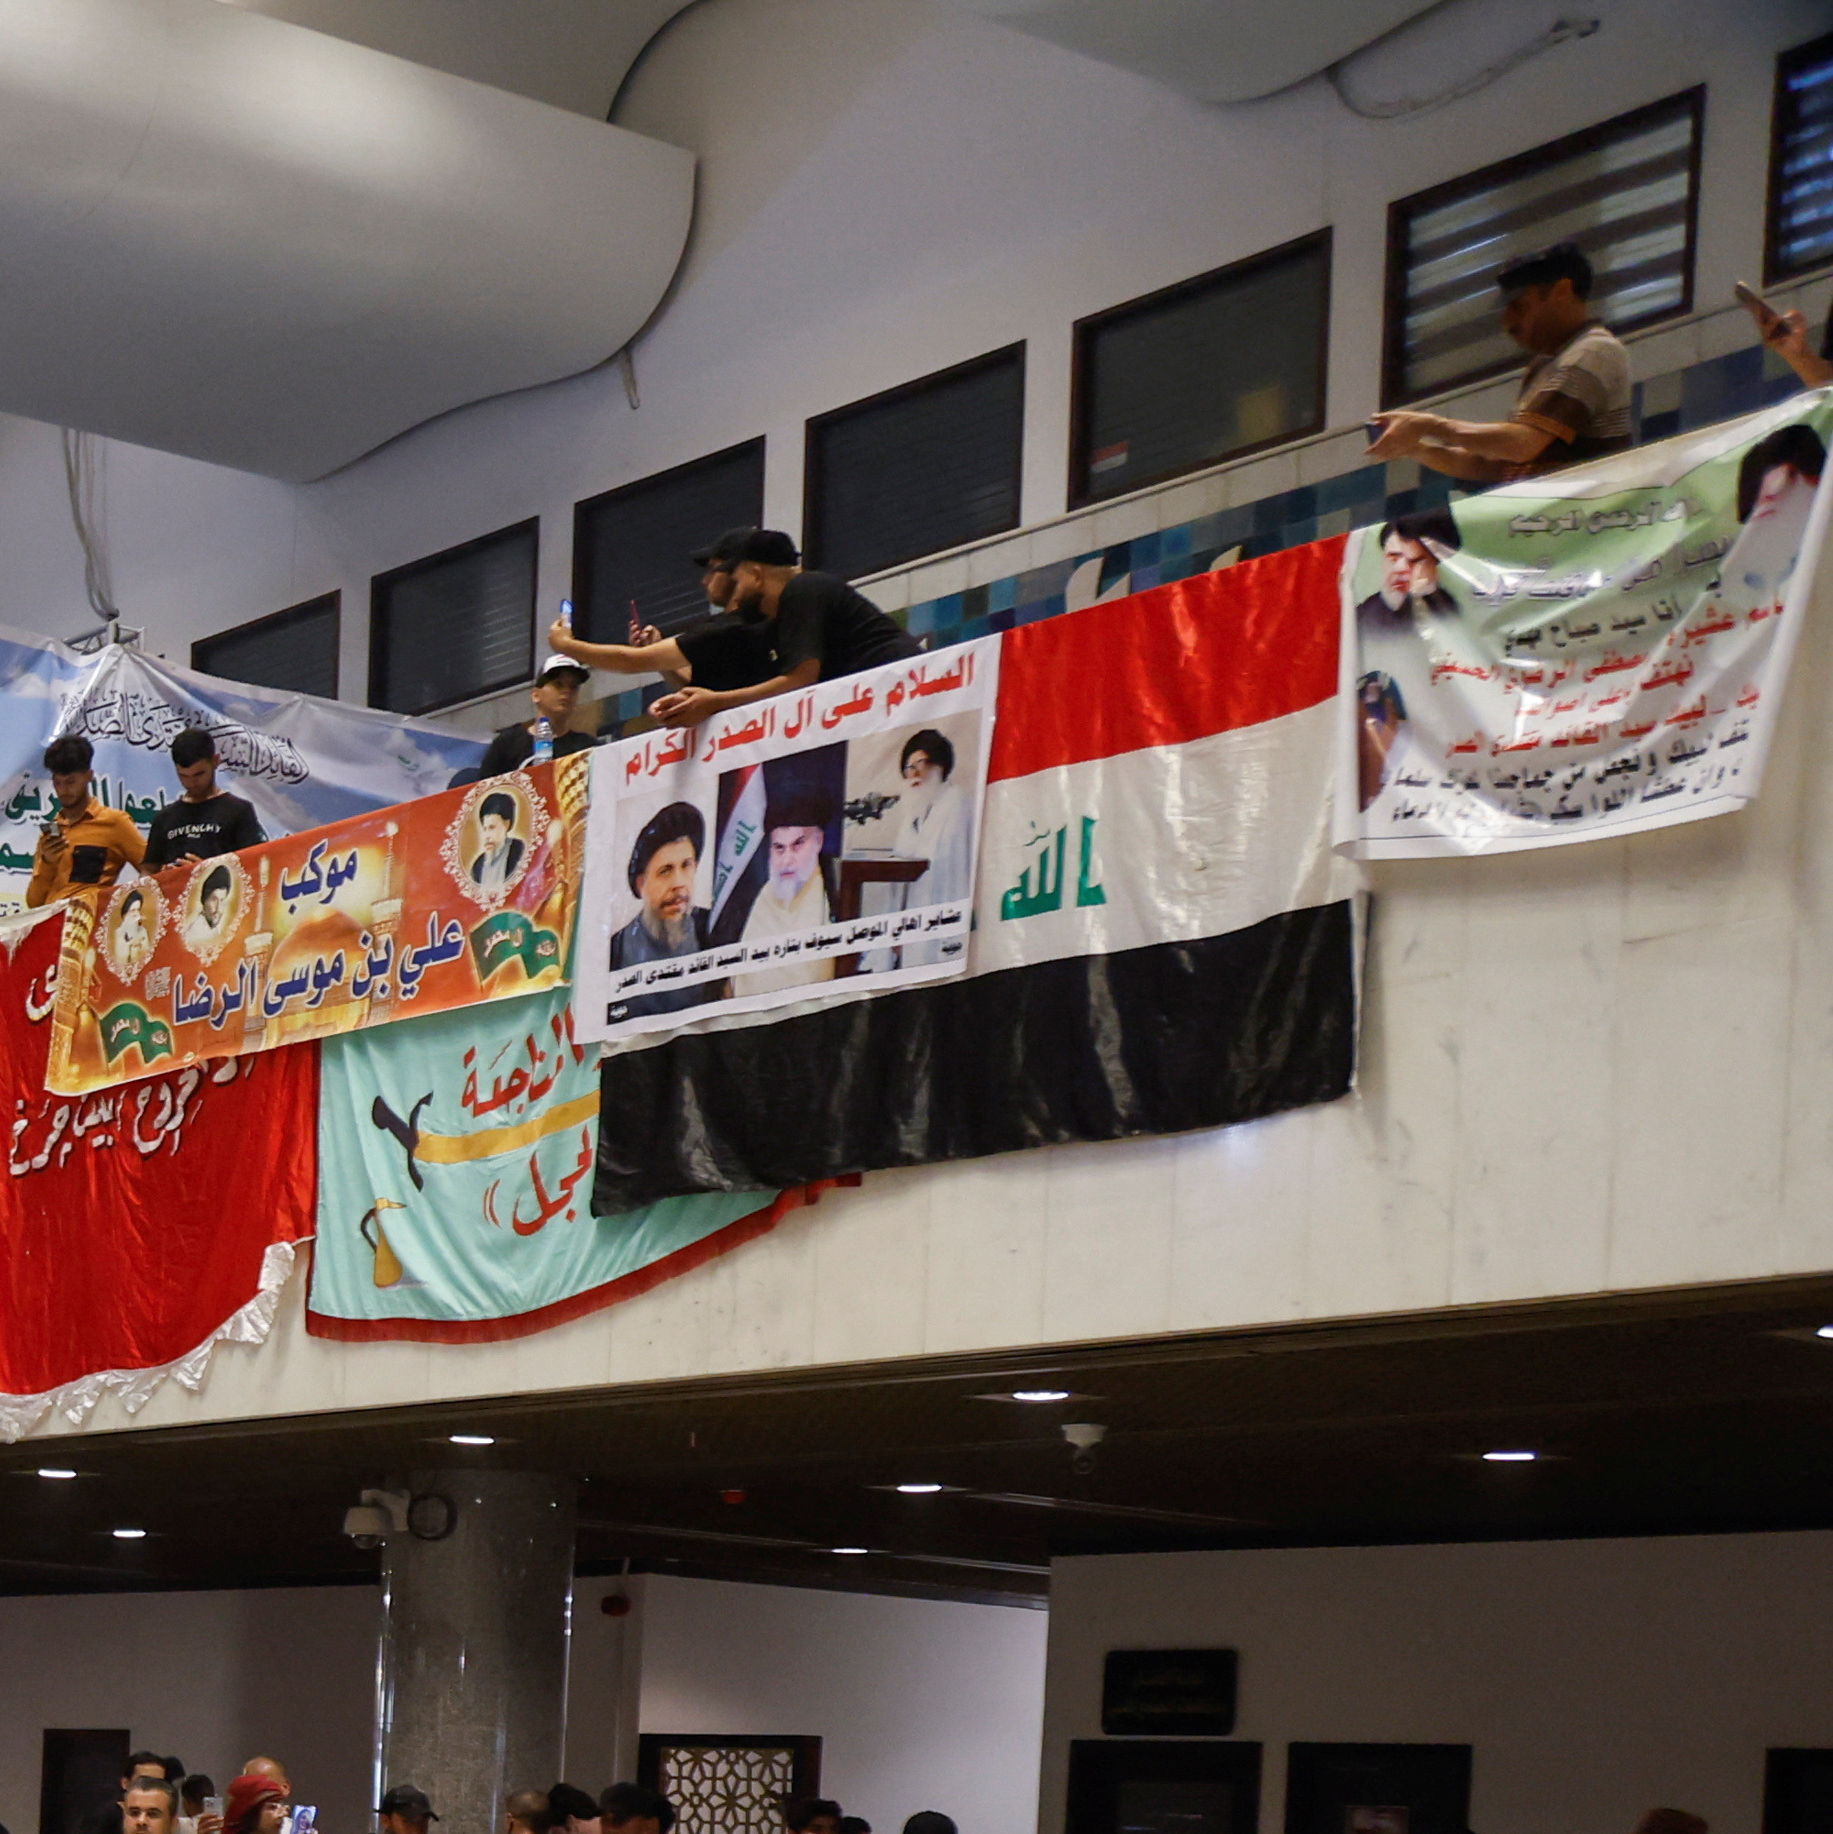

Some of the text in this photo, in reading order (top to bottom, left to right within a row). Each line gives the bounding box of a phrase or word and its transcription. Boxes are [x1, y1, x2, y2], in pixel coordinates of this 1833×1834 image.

[821, 688, 875, 732] على
[884, 653, 976, 716] السلام
[701, 712, 777, 763] الصدر
[280, 838, 357, 914] موكب
[173, 911, 465, 1029] علي بن موسى الرضا
